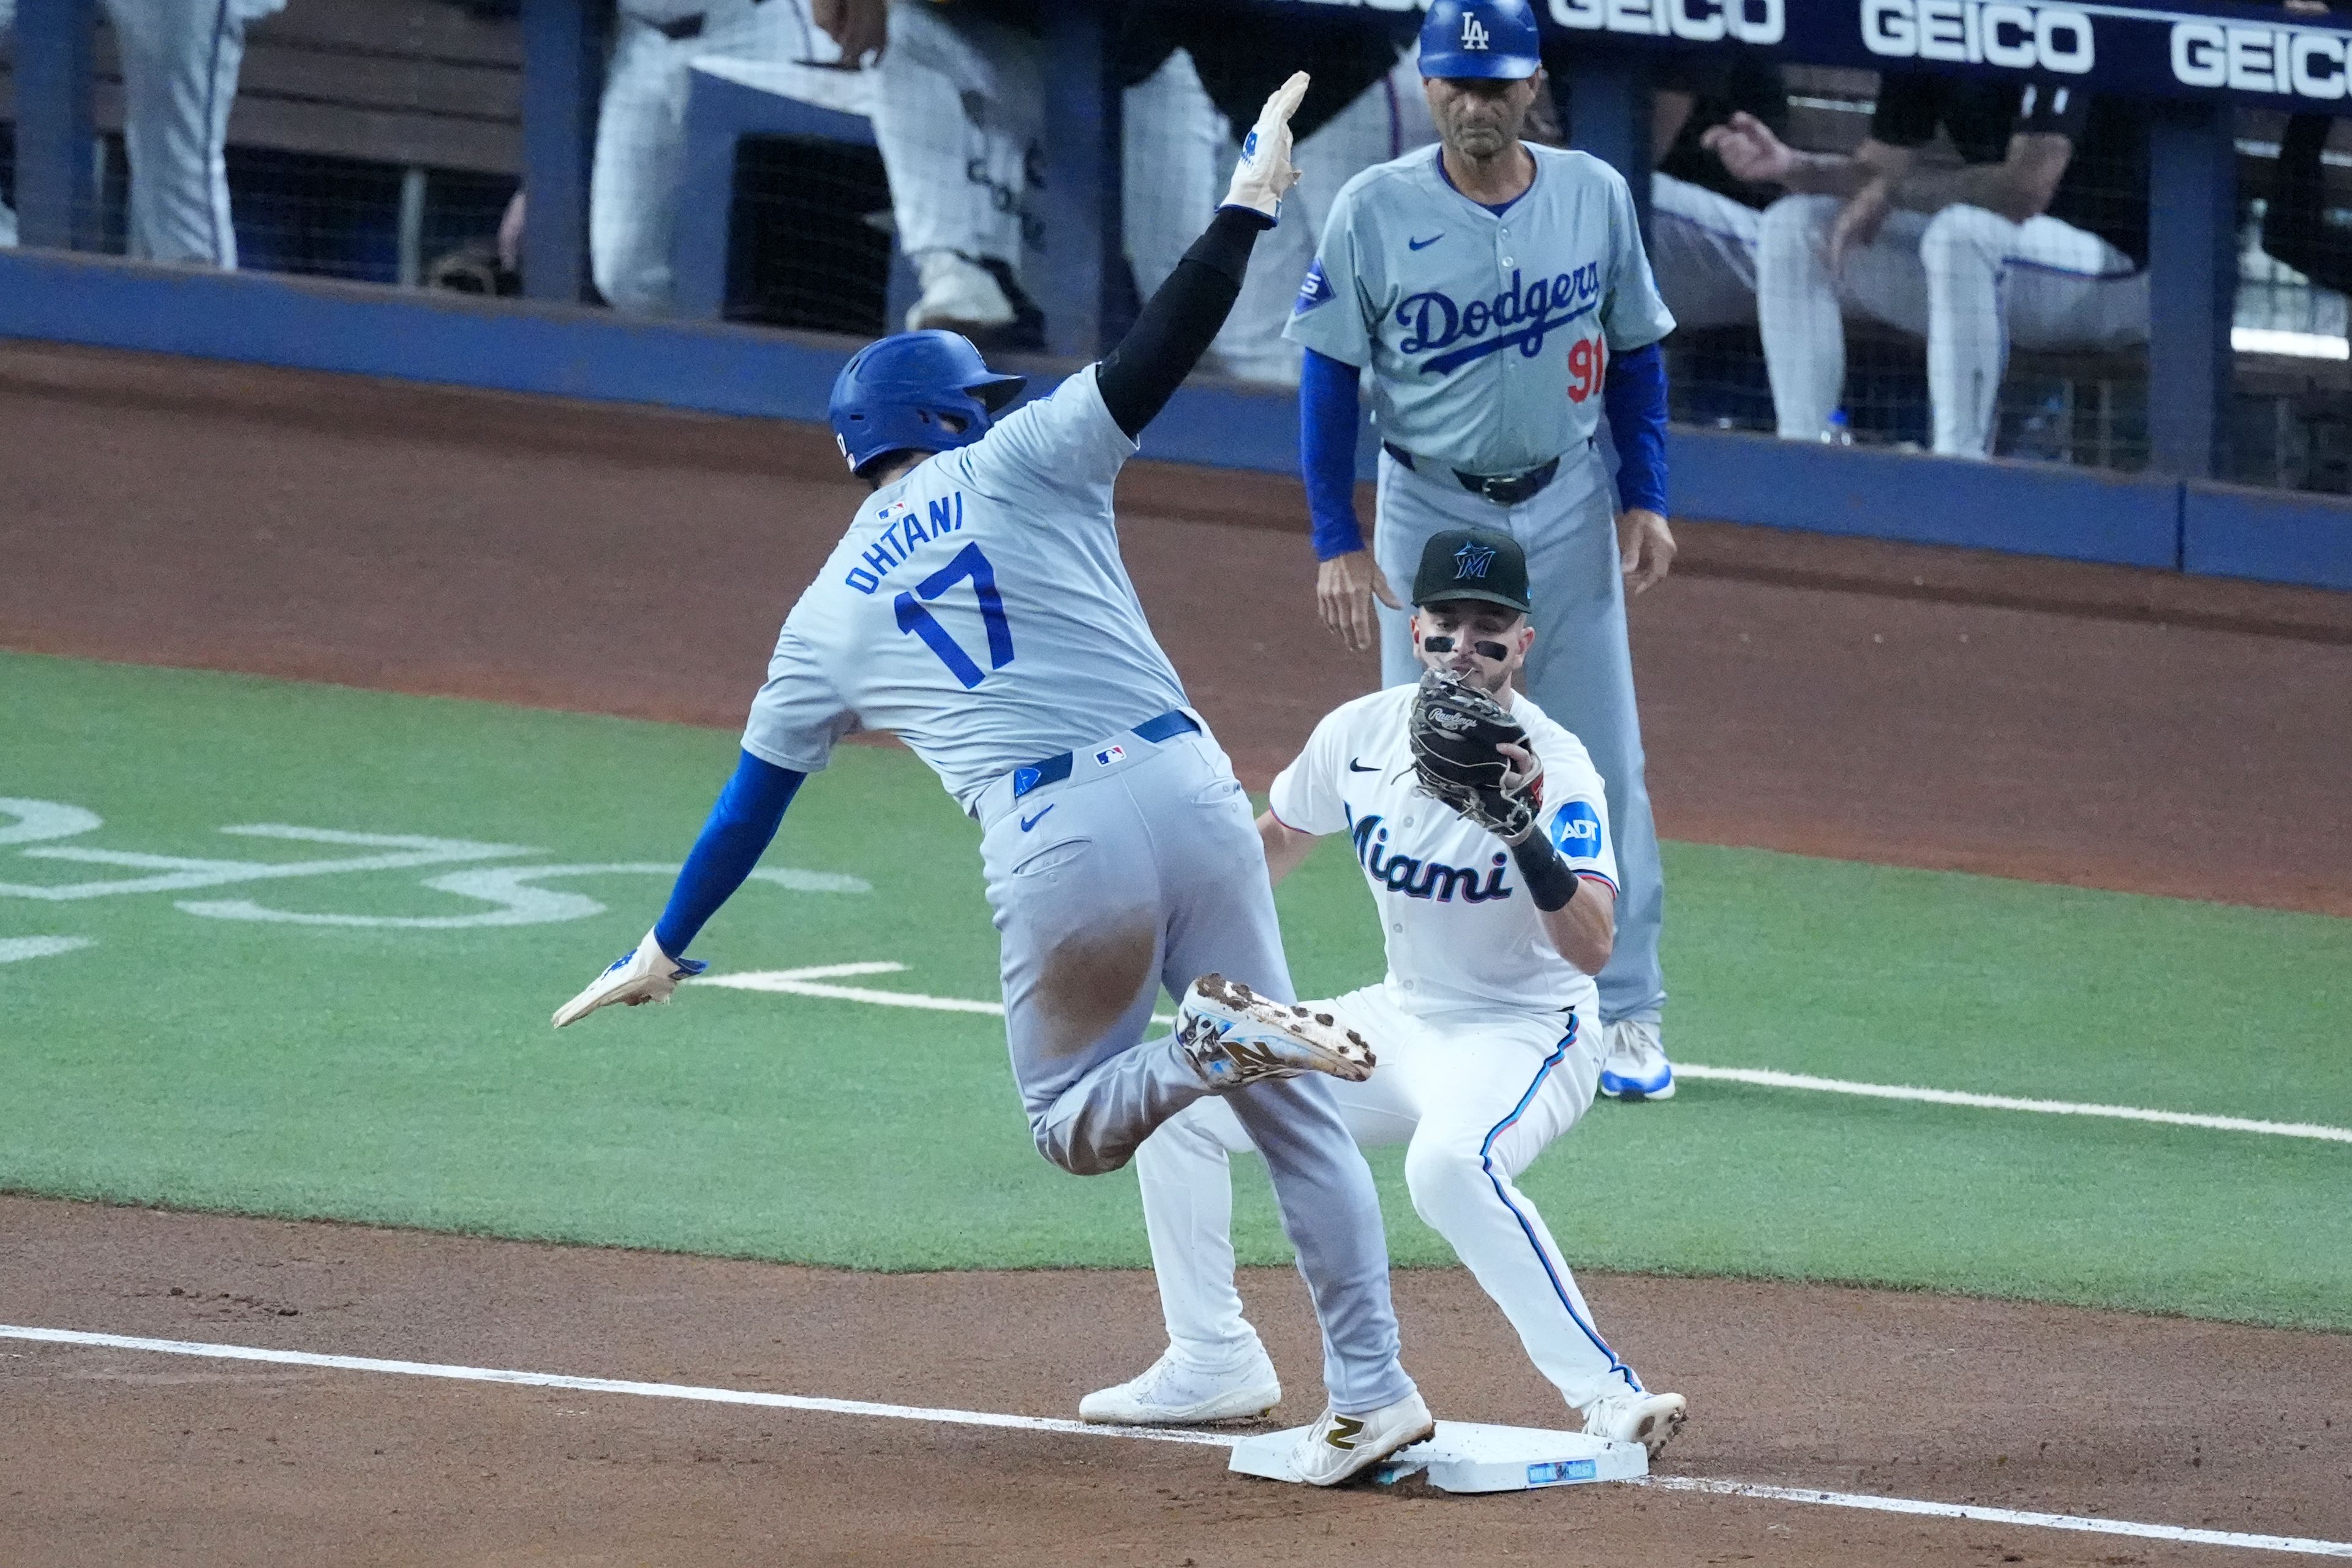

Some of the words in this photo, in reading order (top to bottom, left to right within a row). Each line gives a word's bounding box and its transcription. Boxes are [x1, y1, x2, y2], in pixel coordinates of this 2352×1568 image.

[1461, 11, 1489, 50] LA
[1860, 0, 2095, 74] GEICO
[2170, 23, 2352, 100] GEIC
[1395, 262, 1600, 363] Dodgers
[1567, 333, 1604, 404] 91
[845, 491, 963, 595] OHTANI
[894, 540, 1015, 690] 17
[1428, 707, 1478, 731] Rawlings
[1343, 799, 1513, 904] Miami
[1560, 819, 1598, 842] ADT
